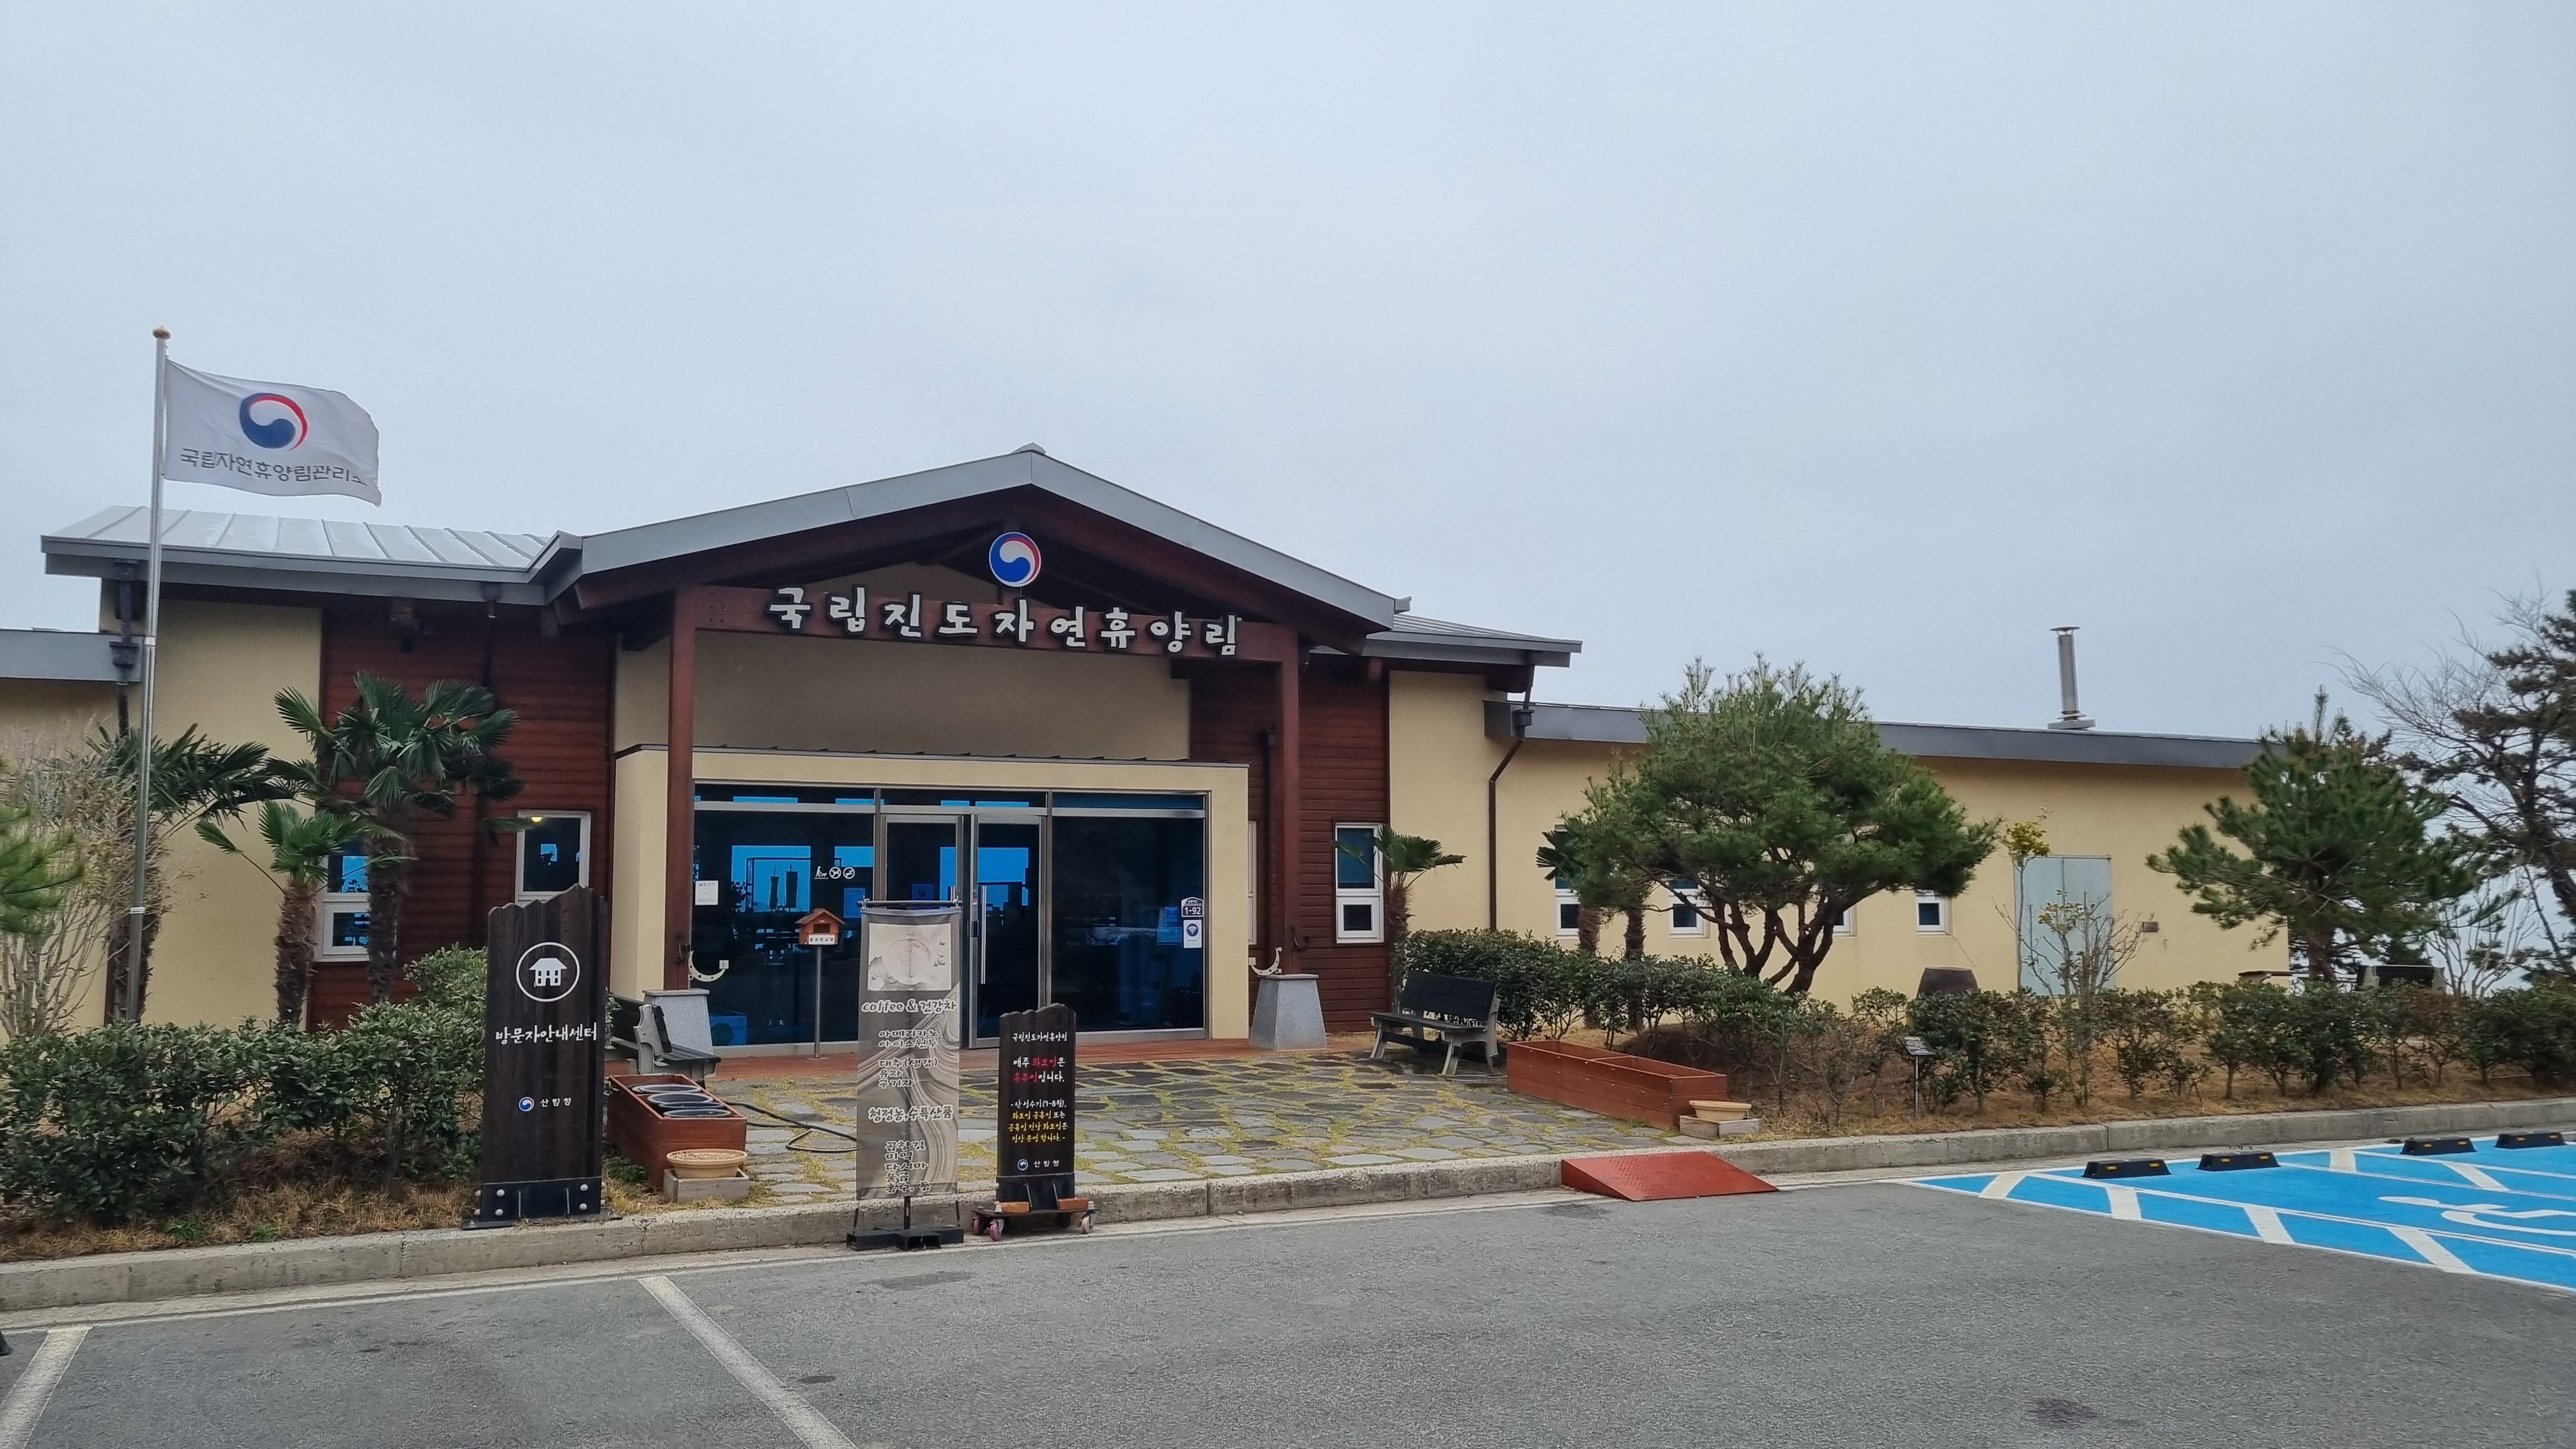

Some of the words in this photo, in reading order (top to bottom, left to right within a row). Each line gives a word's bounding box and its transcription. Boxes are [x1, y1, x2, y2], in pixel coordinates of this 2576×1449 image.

[769, 586, 1240, 657] 국립진도자연휴양림
[1184, 907, 1201, 915] 1-92
[862, 1000, 905, 1013] coffee
[906, 999, 918, 1012] &
[919, 999, 957, 1014] 건강차
[495, 1022, 597, 1045] 방문자안내센터
[878, 1029, 940, 1038] 아메리카노
[878, 1038, 937, 1048] 아이스원두
[1013, 1055, 1030, 1068] 매주
[879, 1068, 903, 1078] 유자
[878, 1078, 916, 1088] 구기자
[885, 1151, 914, 1160] 미역
[884, 1162, 928, 1171] 다시마
